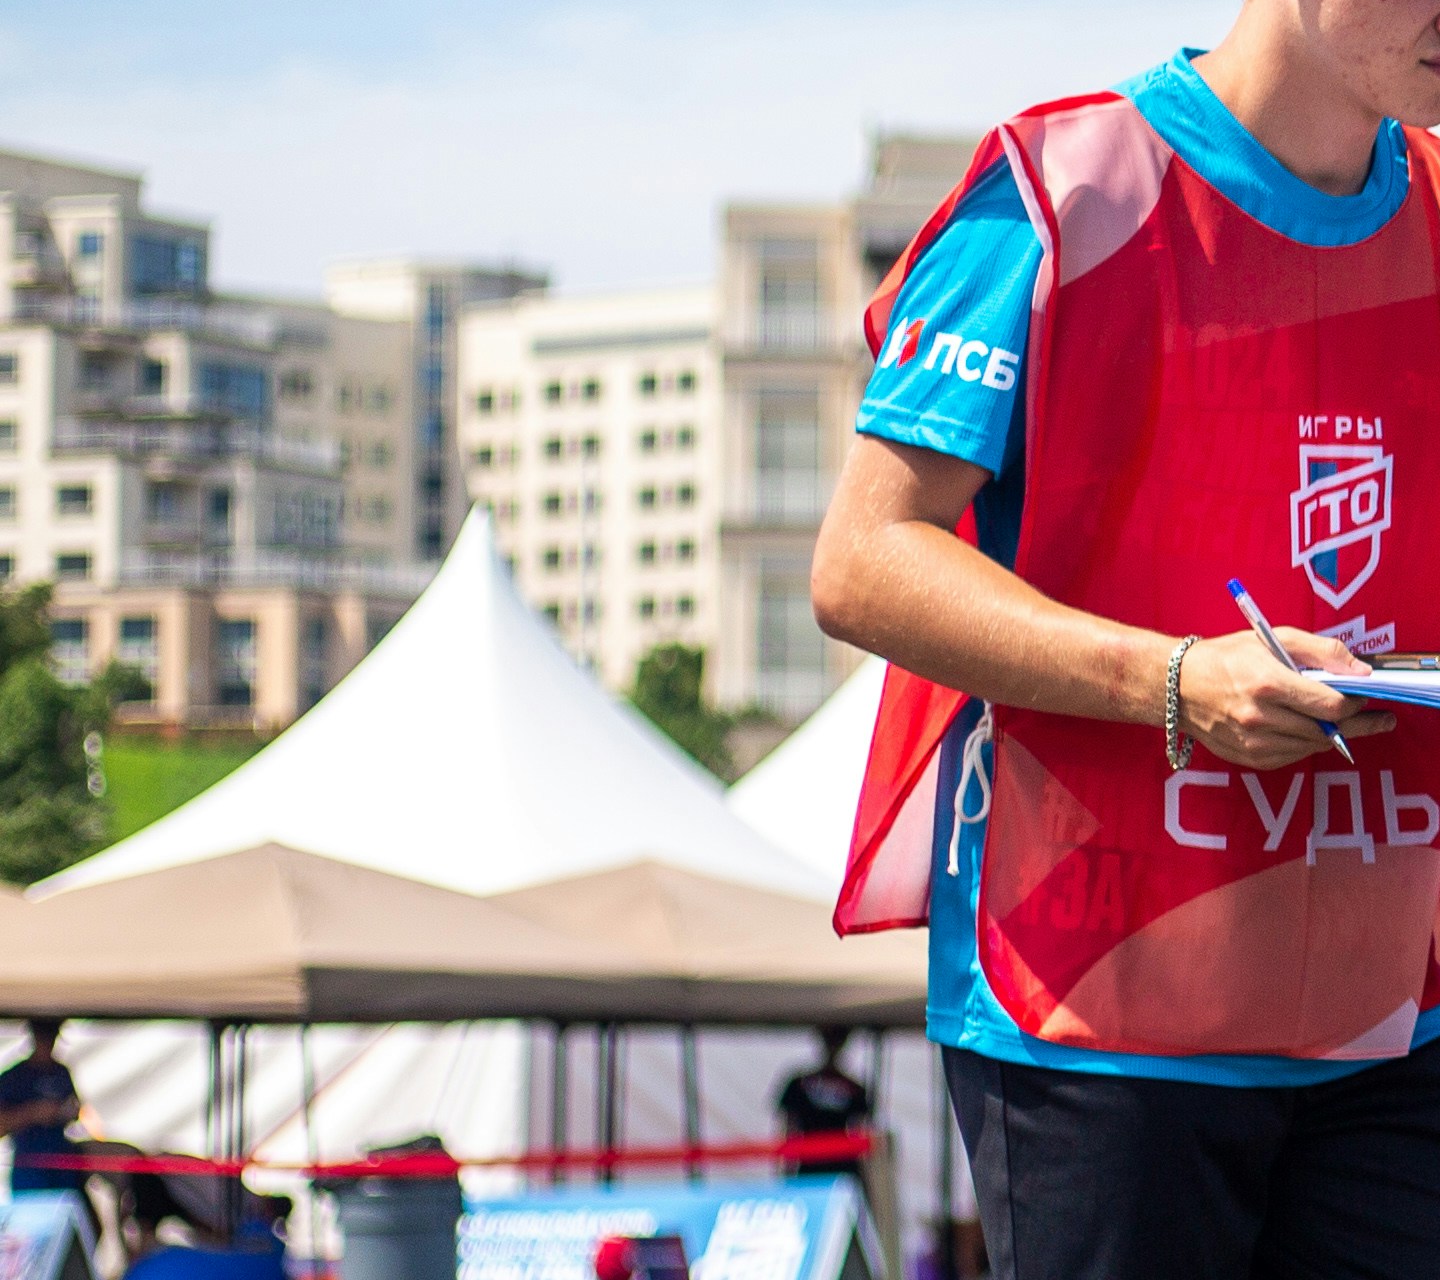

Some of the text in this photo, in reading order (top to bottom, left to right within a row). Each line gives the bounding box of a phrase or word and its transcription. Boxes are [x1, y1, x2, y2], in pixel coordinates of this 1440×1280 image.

[923, 331, 1020, 391] ПСБ
[1299, 415, 1383, 440] ИГРЫ
[1304, 478, 1379, 547] ГТО
